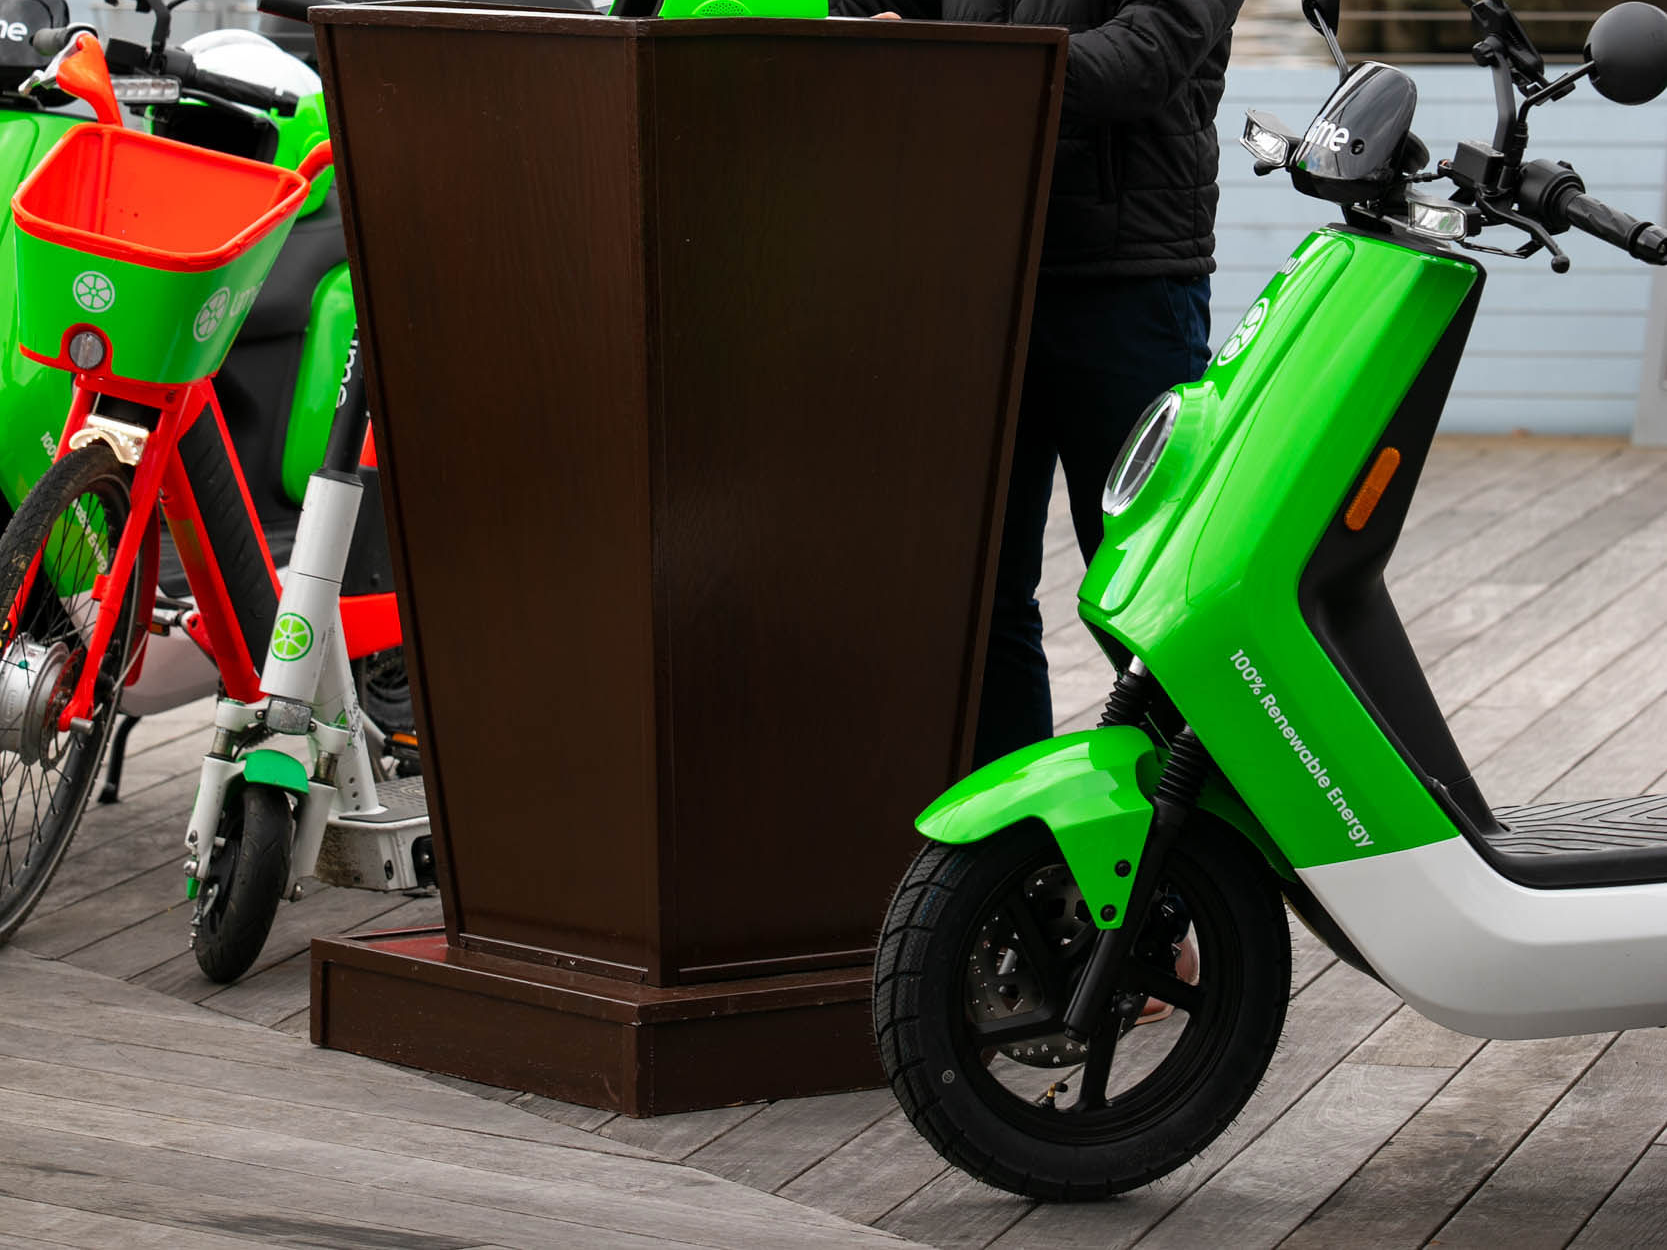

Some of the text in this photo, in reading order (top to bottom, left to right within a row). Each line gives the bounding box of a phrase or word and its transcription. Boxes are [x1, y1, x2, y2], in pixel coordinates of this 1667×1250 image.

[1230, 649, 1375, 849] 100% Renewable Energy
